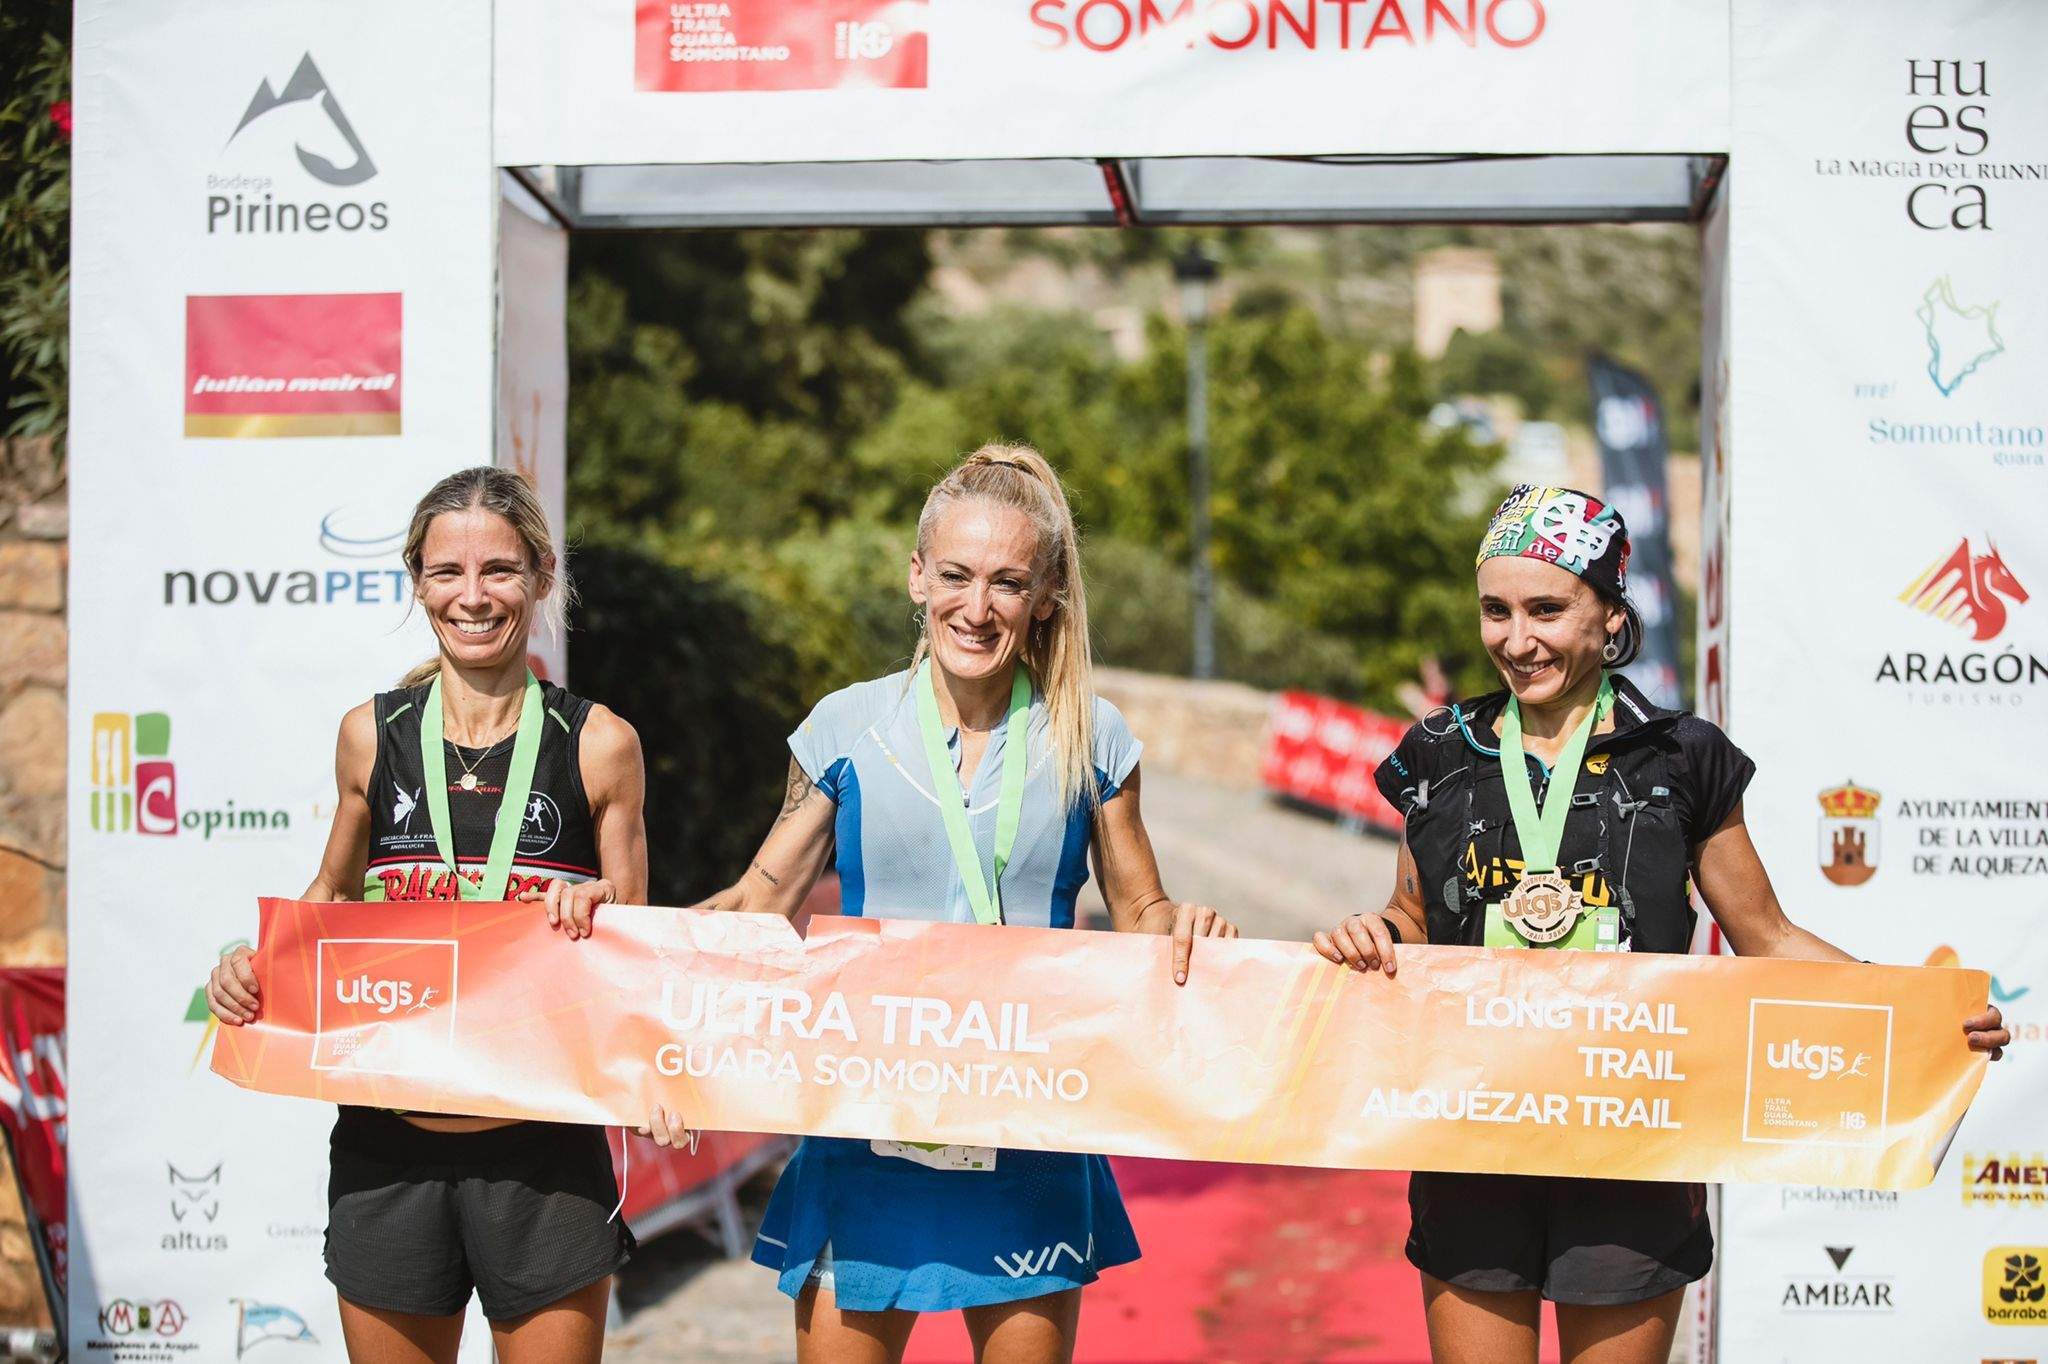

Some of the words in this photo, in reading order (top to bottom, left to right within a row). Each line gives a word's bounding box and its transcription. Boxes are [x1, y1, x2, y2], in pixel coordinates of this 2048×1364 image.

[670, 3, 731, 18] ULTRA
[669, 46, 791, 61] SOMONTANO
[1906, 105, 1989, 156] es
[208, 194, 389, 233] Pirineos
[1869, 418, 2044, 447] Somontano
[163, 570, 408, 604] novaPET
[1876, 644, 2048, 684] ARAGÓN
[1957, 829, 1984, 847] LA
[337, 974, 413, 1013] utgs
[662, 980, 859, 1042] ULTRA
[872, 994, 1050, 1053] TRAIL
[1466, 996, 1573, 1029] LONG
[1583, 999, 1688, 1035] TRAIL
[655, 1043, 802, 1083] GUARA
[813, 1053, 1089, 1102] SOMONTANO
[1578, 1046, 1686, 1081] TRAIL
[1767, 1039, 1844, 1080] utgs
[1360, 1083, 1569, 1126] ALQUÉZAR
[1575, 1095, 1682, 1130] TRAIL
[161, 1230, 228, 1250] altus
[1782, 1283, 1894, 1306] AMBAR
